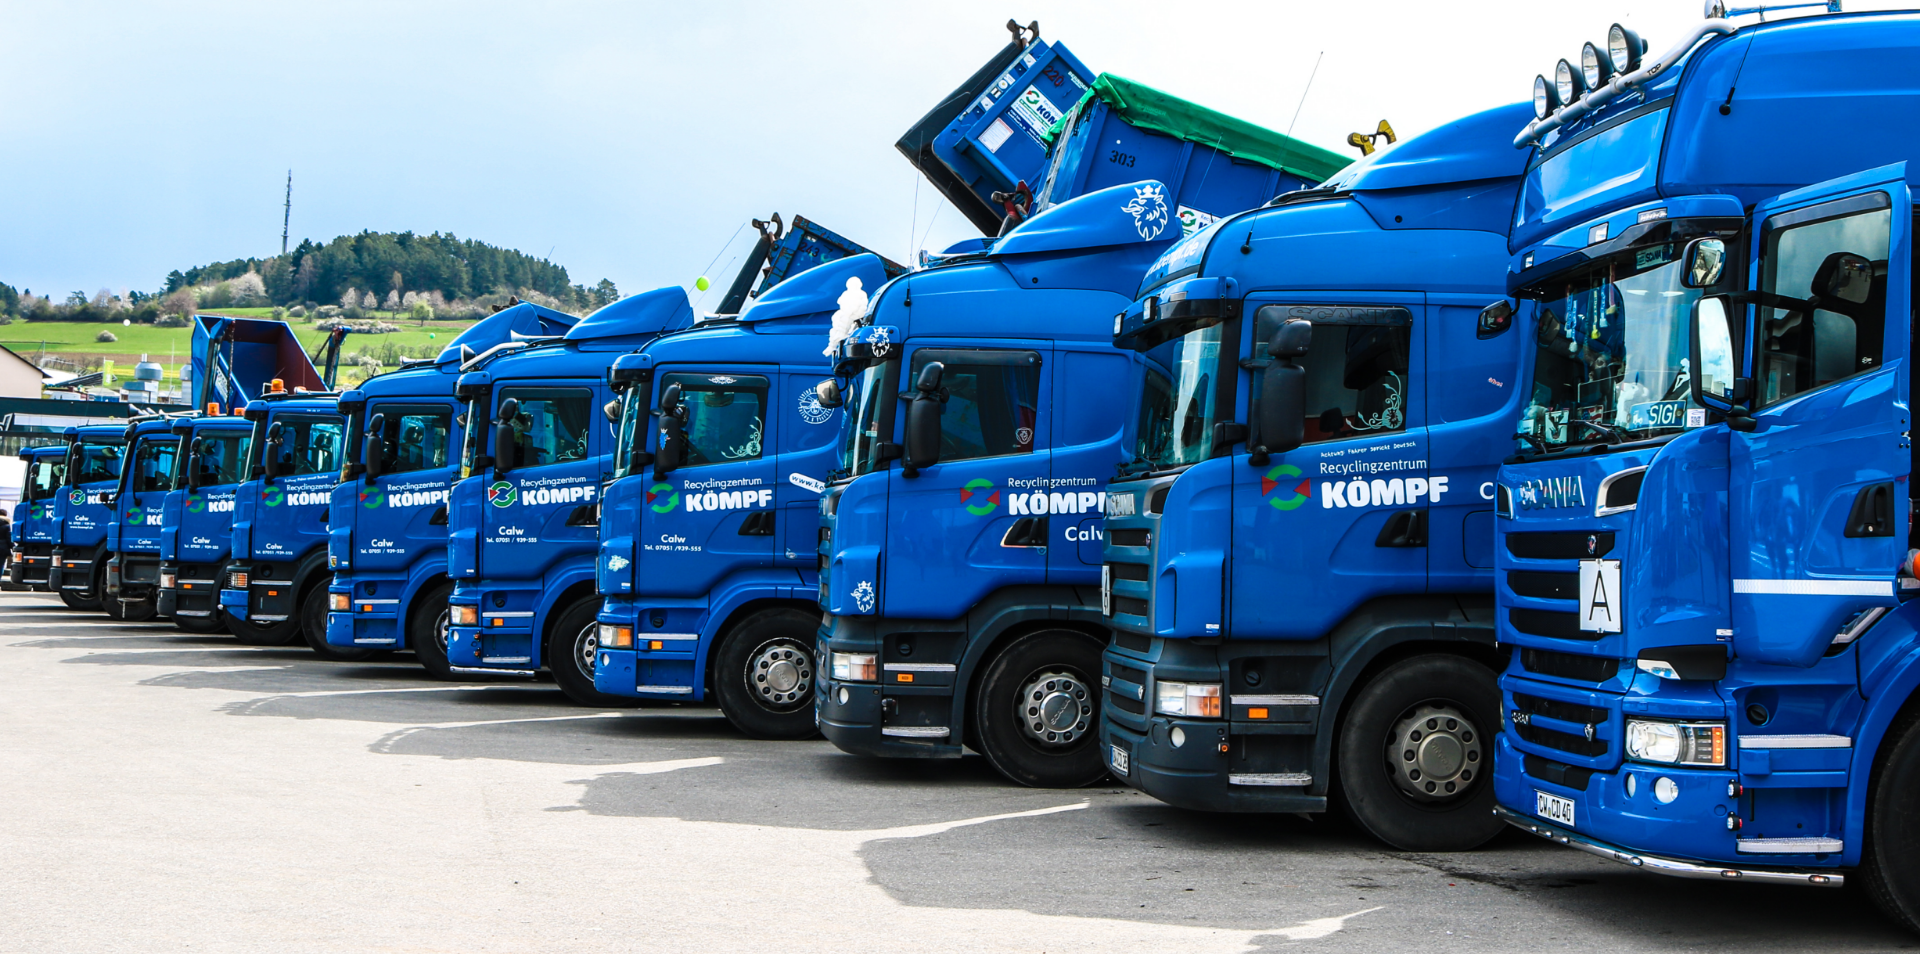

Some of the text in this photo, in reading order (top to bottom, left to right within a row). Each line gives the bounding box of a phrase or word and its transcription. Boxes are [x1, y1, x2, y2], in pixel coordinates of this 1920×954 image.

[1043, 65, 1064, 86] 220
[1647, 63, 1661, 76] TOP
[1109, 149, 1136, 168] 303
[799, 242, 820, 257] 243
[1288, 306, 1405, 325] SCANIA
[1650, 403, 1678, 425] SIGI
[1319, 459, 1427, 476] Recyclingzentrum
[387, 481, 445, 492] Recyclingzentrum
[520, 476, 587, 489] Recyclingzentrum
[684, 477, 762, 491] Recyclingzentrum
[1008, 477, 1097, 490] Recyclingzentrum
[522, 486, 596, 506] KÖMPF
[685, 489, 773, 513] KÖMPF
[1321, 476, 1449, 509] KÖMPF
[1519, 475, 1586, 510] SCANIA
[498, 525, 525, 536] Calw
[661, 533, 686, 543] Calw
[192, 536, 211, 544] Calw
[371, 538, 394, 548] Calw
[1588, 569, 1612, 622] A
[1551, 798, 1561, 819] CD
